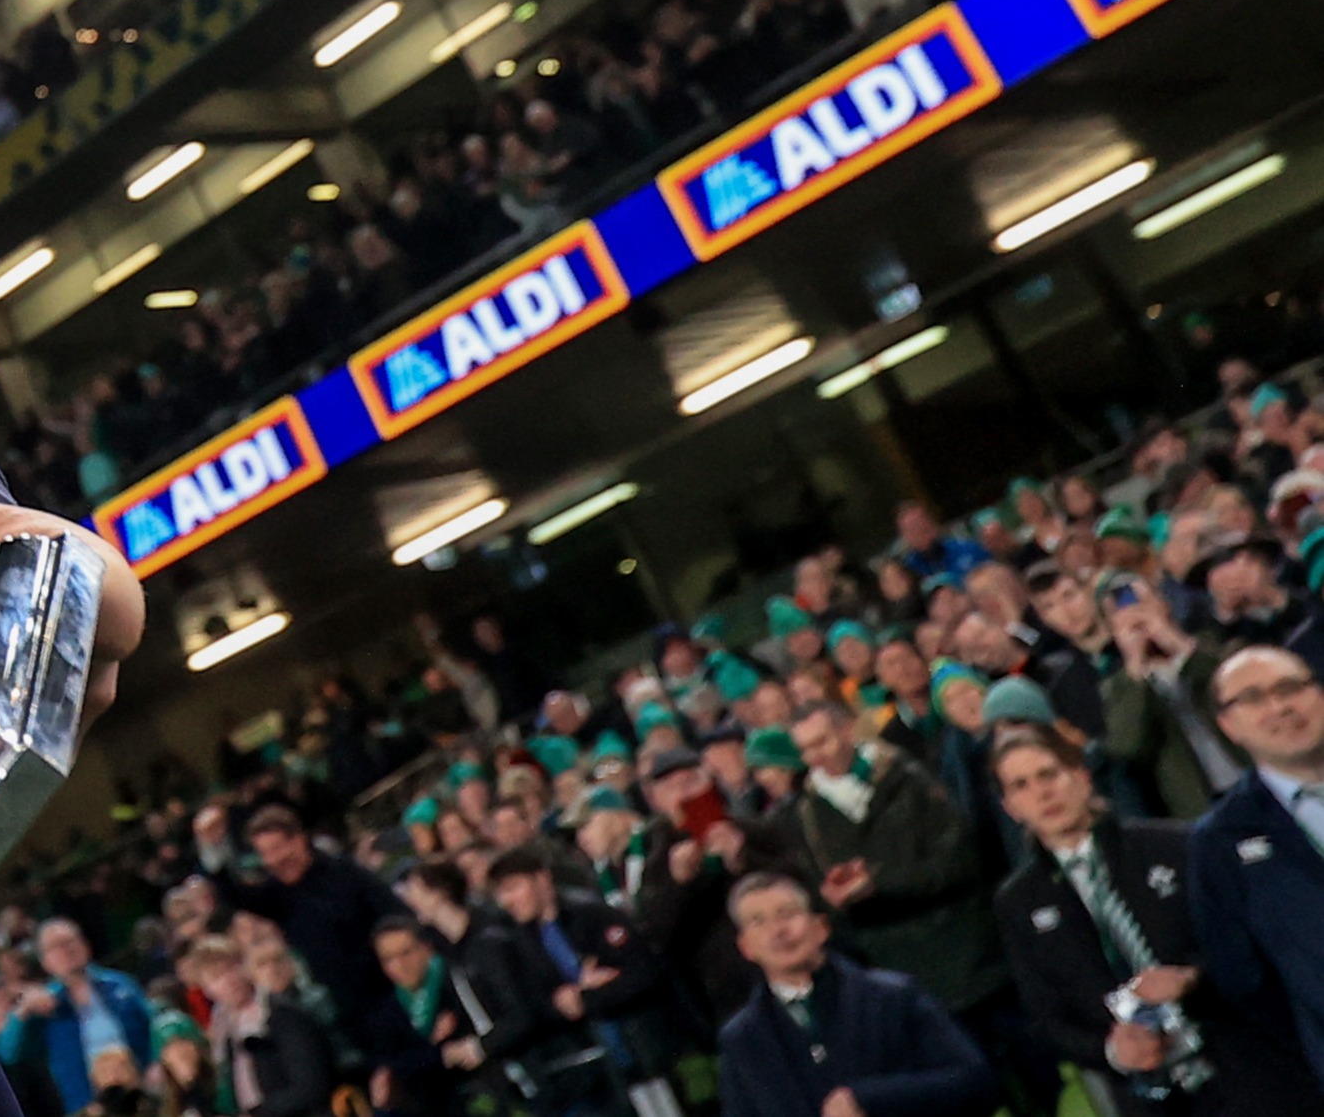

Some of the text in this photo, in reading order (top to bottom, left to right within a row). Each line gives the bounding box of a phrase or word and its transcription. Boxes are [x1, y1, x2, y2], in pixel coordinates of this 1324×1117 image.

[769, 42, 948, 191] ALDI
[440, 254, 587, 380] ALDI
[168, 426, 291, 535] ALDI
